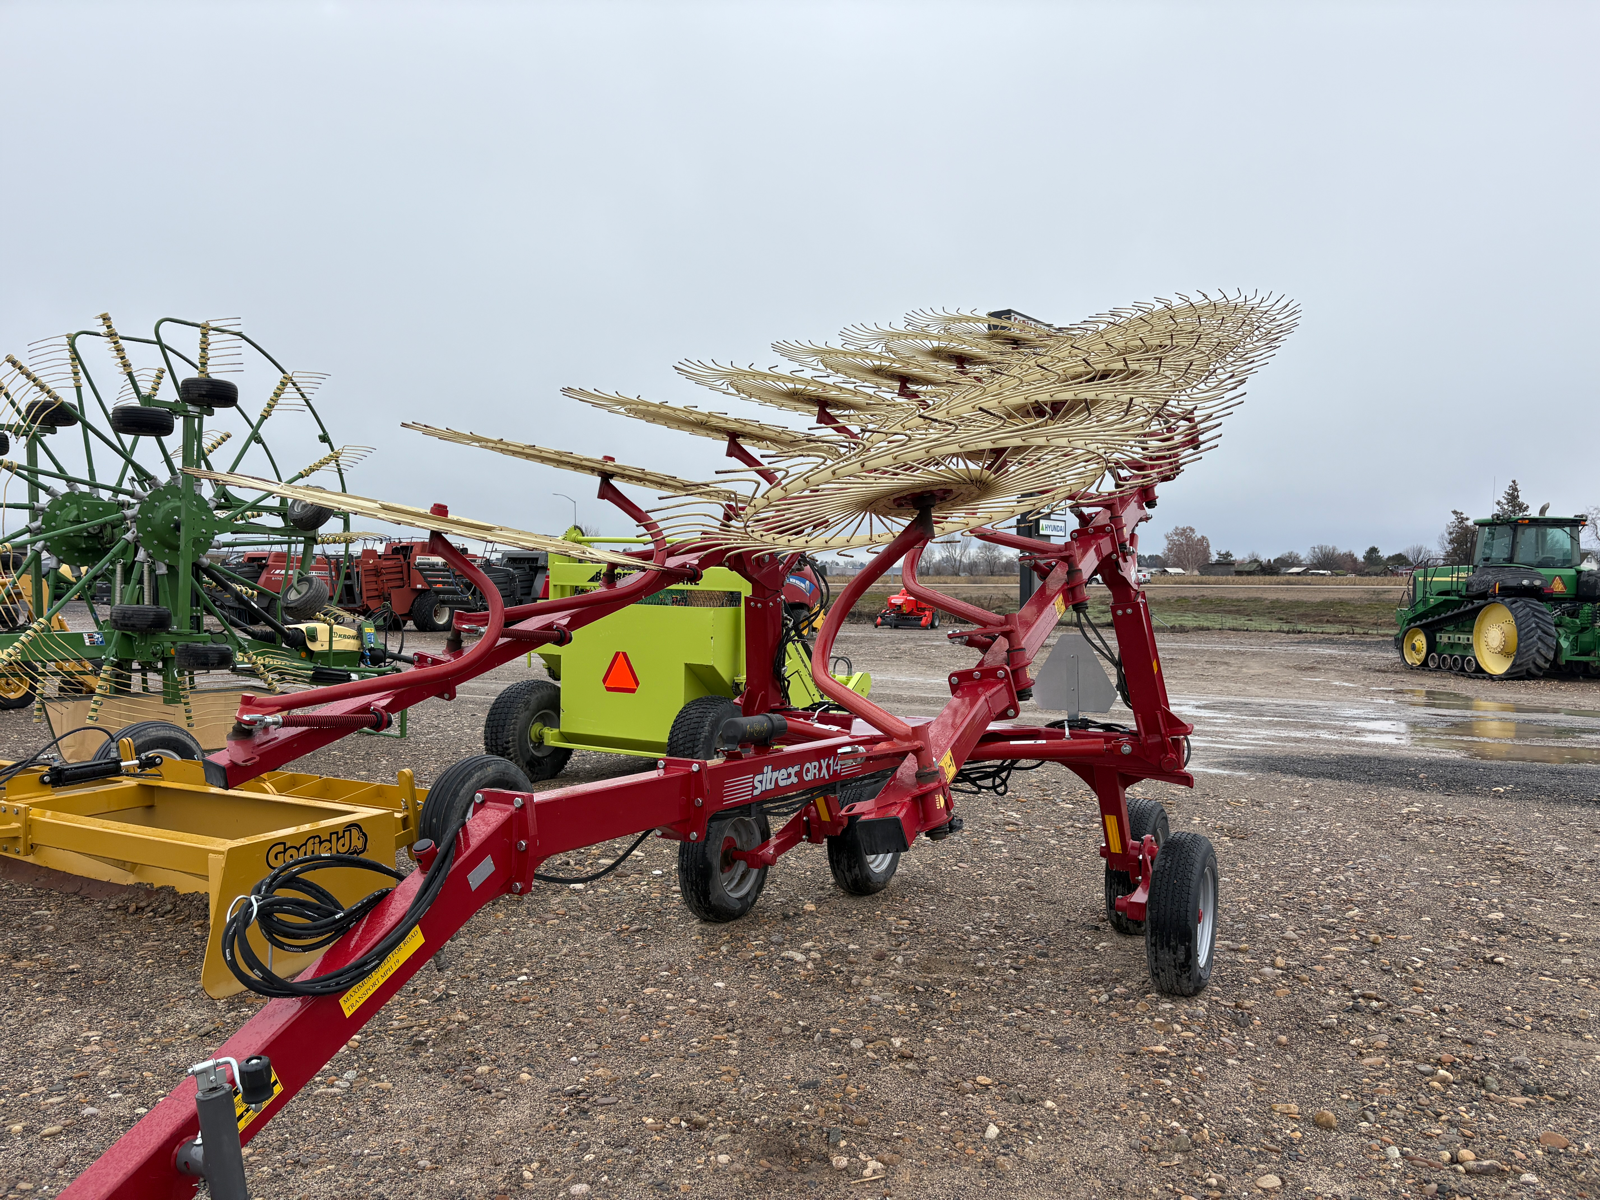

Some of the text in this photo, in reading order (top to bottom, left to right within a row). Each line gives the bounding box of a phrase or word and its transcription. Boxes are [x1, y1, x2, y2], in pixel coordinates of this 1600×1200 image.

[1045, 524, 1065, 532] HYUNDAI
[753, 764, 801, 796] sitrex
[266, 830, 352, 870] Garfield
[342, 973, 375, 1005] MAXIMUM
[374, 955, 392, 975] SPEED
[391, 946, 403, 958] FOR
[402, 930, 419, 947] ROAD
[346, 978, 381, 1012] TRANSPORT
[380, 965, 394, 980] MPH
[393, 958, 400, 967] 19
